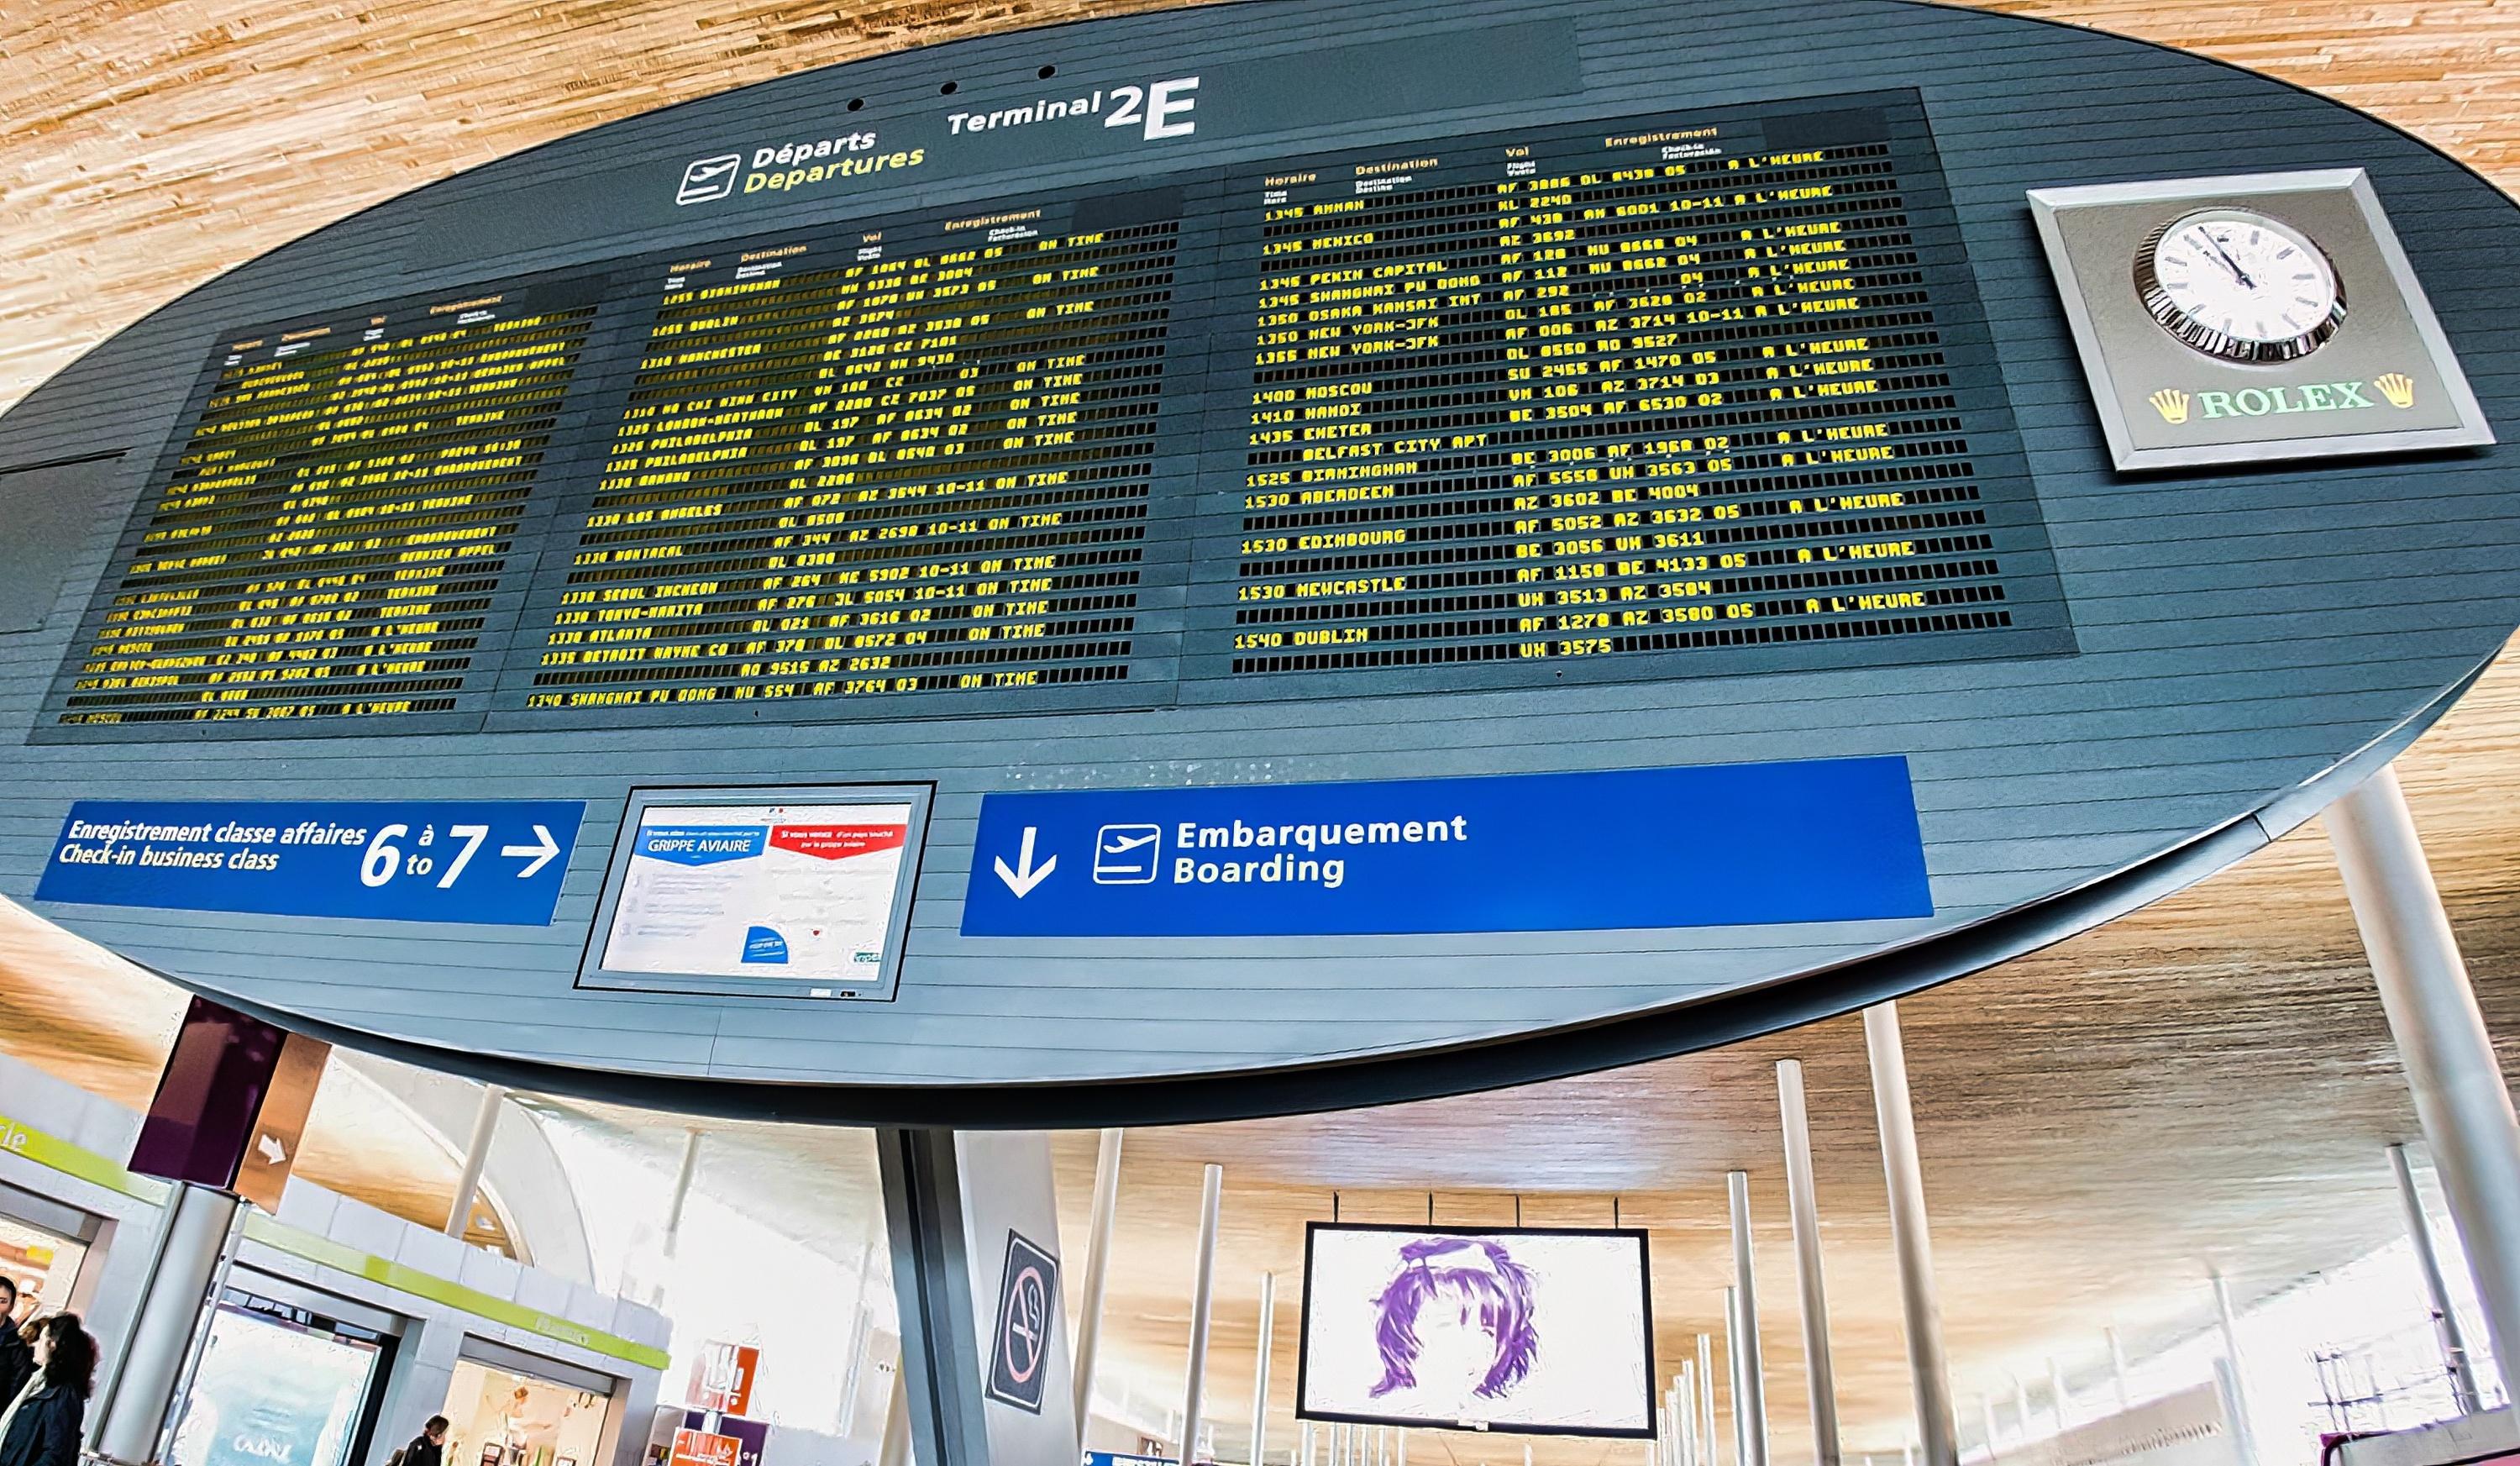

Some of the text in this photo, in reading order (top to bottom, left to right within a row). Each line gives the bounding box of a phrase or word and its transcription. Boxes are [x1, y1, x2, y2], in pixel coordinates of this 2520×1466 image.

[948, 76, 1200, 141] Terminal 2E
[752, 129, 876, 169] Départs
[1264, 127, 1718, 187] Horaire Destination Vol Enregistrement
[743, 146, 926, 194] Departures
[1373, 261, 1446, 278] CAPITAL
[1635, 355, 1681, 370] 1470
[1306, 383, 1372, 399] MOSCOU
[2198, 381, 2376, 419] ROLEX
[1303, 444, 1382, 460] BELFAST
[1394, 439, 1440, 453] CITY
[1247, 472, 1289, 486] 1525
[1246, 494, 1289, 508] 1530
[1551, 492, 1599, 507] 3602
[1649, 484, 1698, 498] 4004
[1552, 516, 1601, 531] 5052
[1652, 507, 1701, 523] 3632
[1714, 505, 1739, 519] 05
[1242, 539, 1287, 554] 1530
[1555, 539, 1603, 555] 3056
[1655, 533, 1704, 548] 3611
[1656, 557, 1707, 572] 4133
[1720, 554, 1746, 568] 05
[1240, 586, 1284, 601] 1530
[1297, 577, 1404, 596] NEWCASTLE
[1558, 588, 1607, 605] 3513
[1727, 603, 1753, 618] 05
[1236, 628, 1610, 655] 1540 DUBLIN 3575
[68, 820, 366, 847] Enregistrement classe affaires
[648, 839, 752, 853] GRIPPE AVIAIRE
[1178, 815, 1467, 852] Embarquement
[58, 844, 281, 871] Check-in business class
[360, 824, 490, 890] 6 à 7
[407, 854, 433, 875] to
[1173, 854, 1344, 888] Boarding
